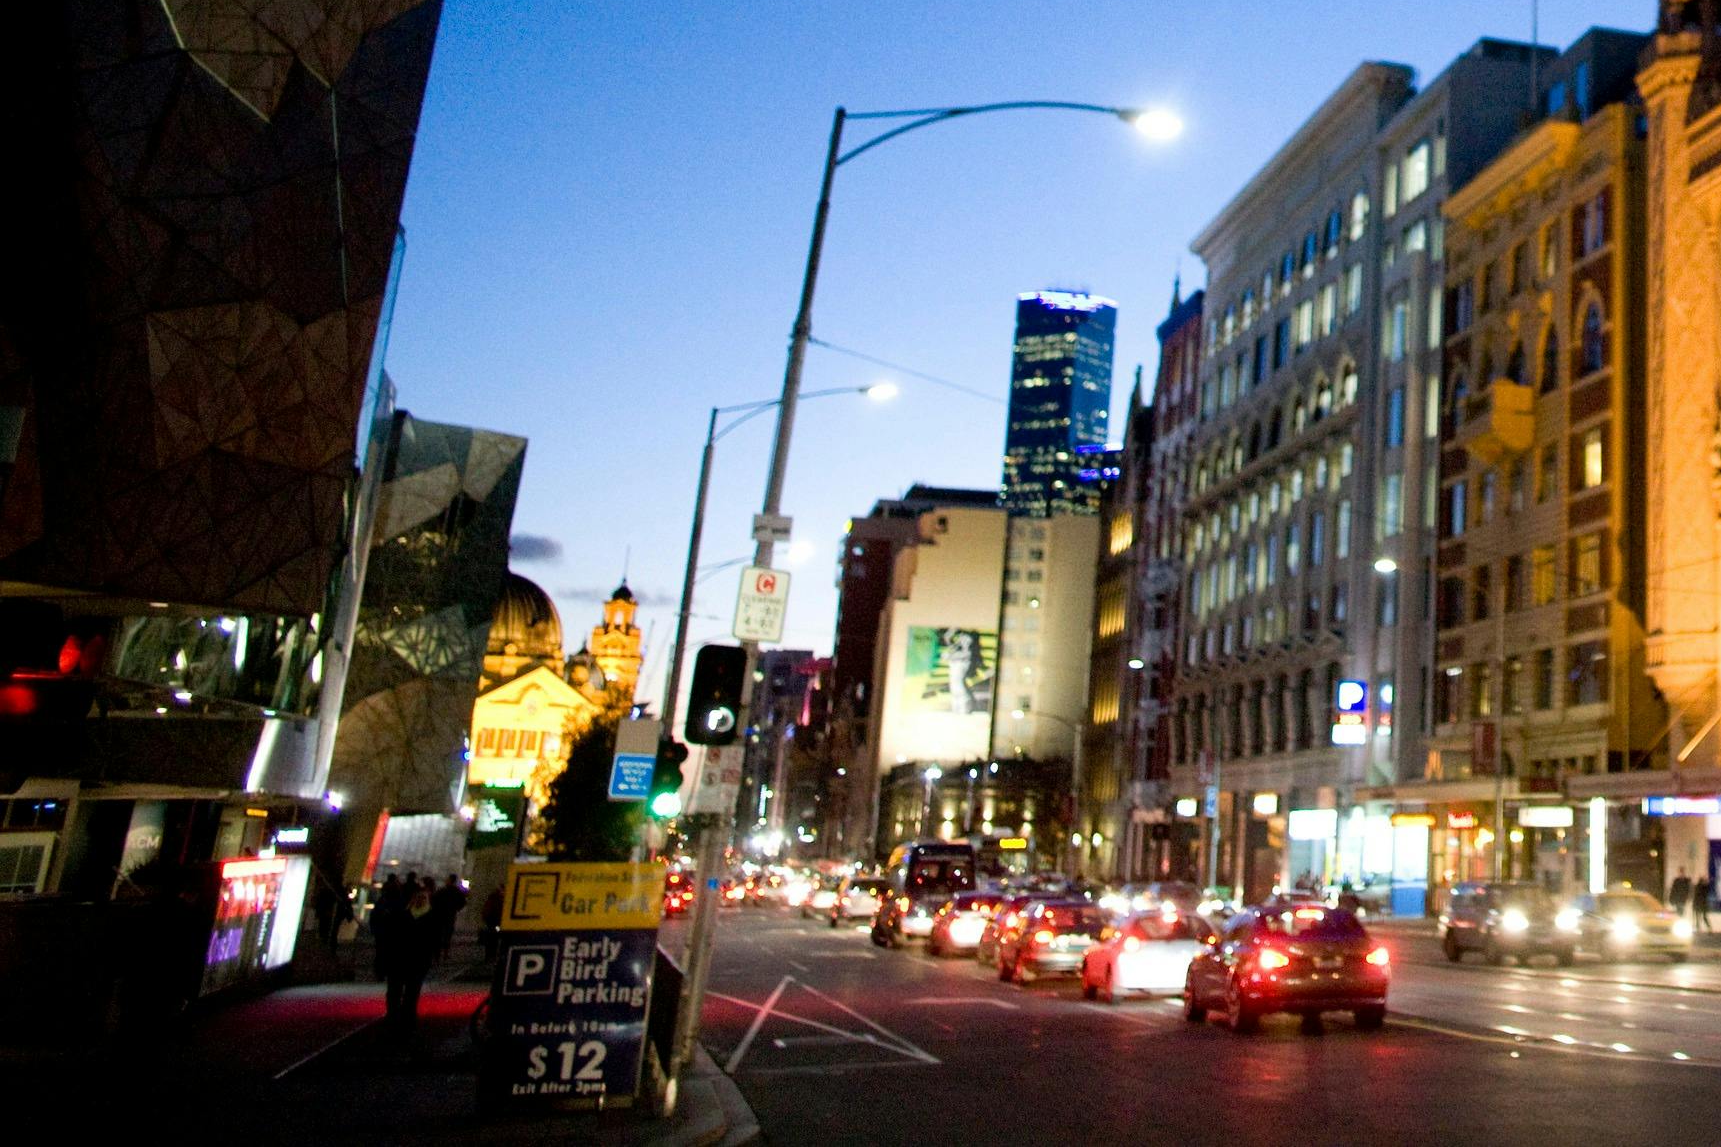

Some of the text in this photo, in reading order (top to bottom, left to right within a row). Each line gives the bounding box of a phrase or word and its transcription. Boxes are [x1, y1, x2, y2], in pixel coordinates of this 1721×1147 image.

[1338, 682, 1364, 710] P
[560, 892, 597, 914] Car
[563, 936, 622, 962] Early
[516, 953, 545, 987] P
[560, 958, 609, 981] Bird
[557, 981, 645, 1007] Parking
[511, 1023, 525, 1035] In
[530, 1021, 577, 1035] Before
[512, 1081, 606, 1095] Exit After 3pm
